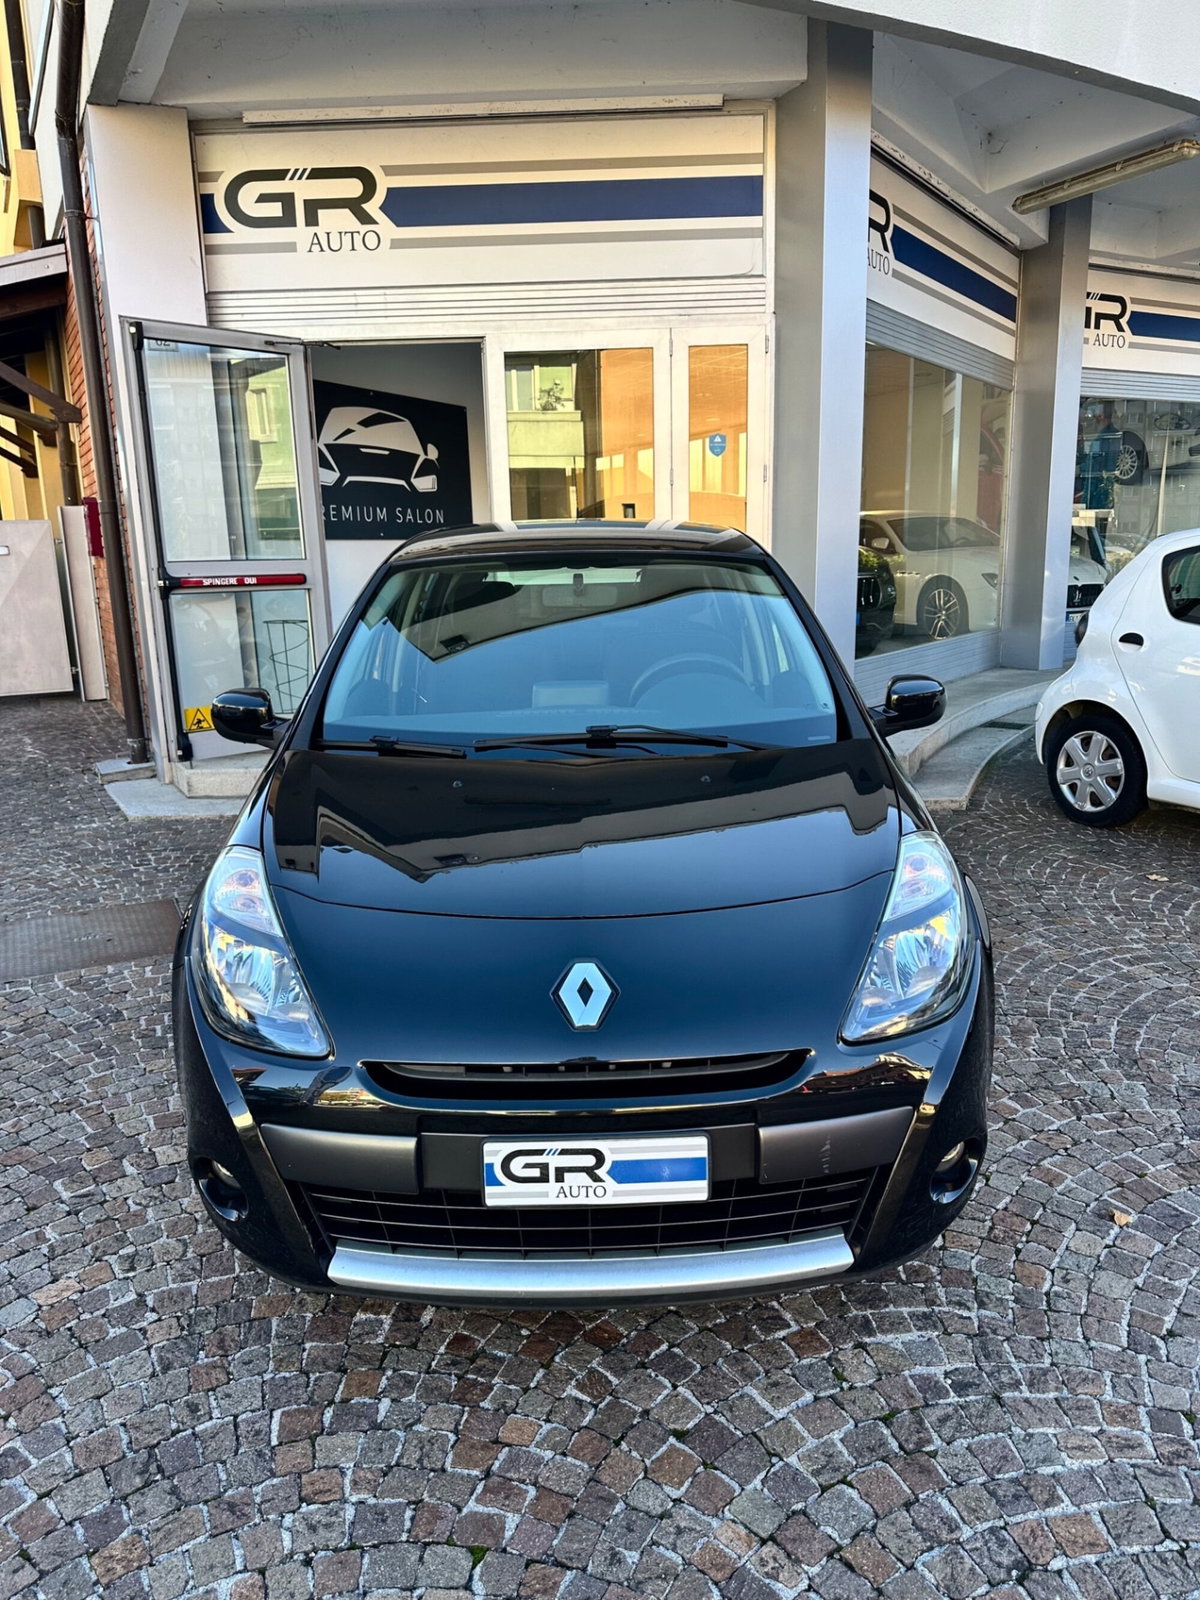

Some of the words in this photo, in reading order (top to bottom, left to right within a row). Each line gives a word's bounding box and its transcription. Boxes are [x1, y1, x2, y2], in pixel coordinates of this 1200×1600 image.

[224, 166, 379, 228] GR
[307, 230, 381, 253] AUTO
[1084, 292, 1126, 332] R
[1093, 333, 1126, 348] AUTO
[395, 507, 444, 524] SALON
[500, 1148, 606, 1183] GR
[556, 1185, 607, 1198] AUTO
